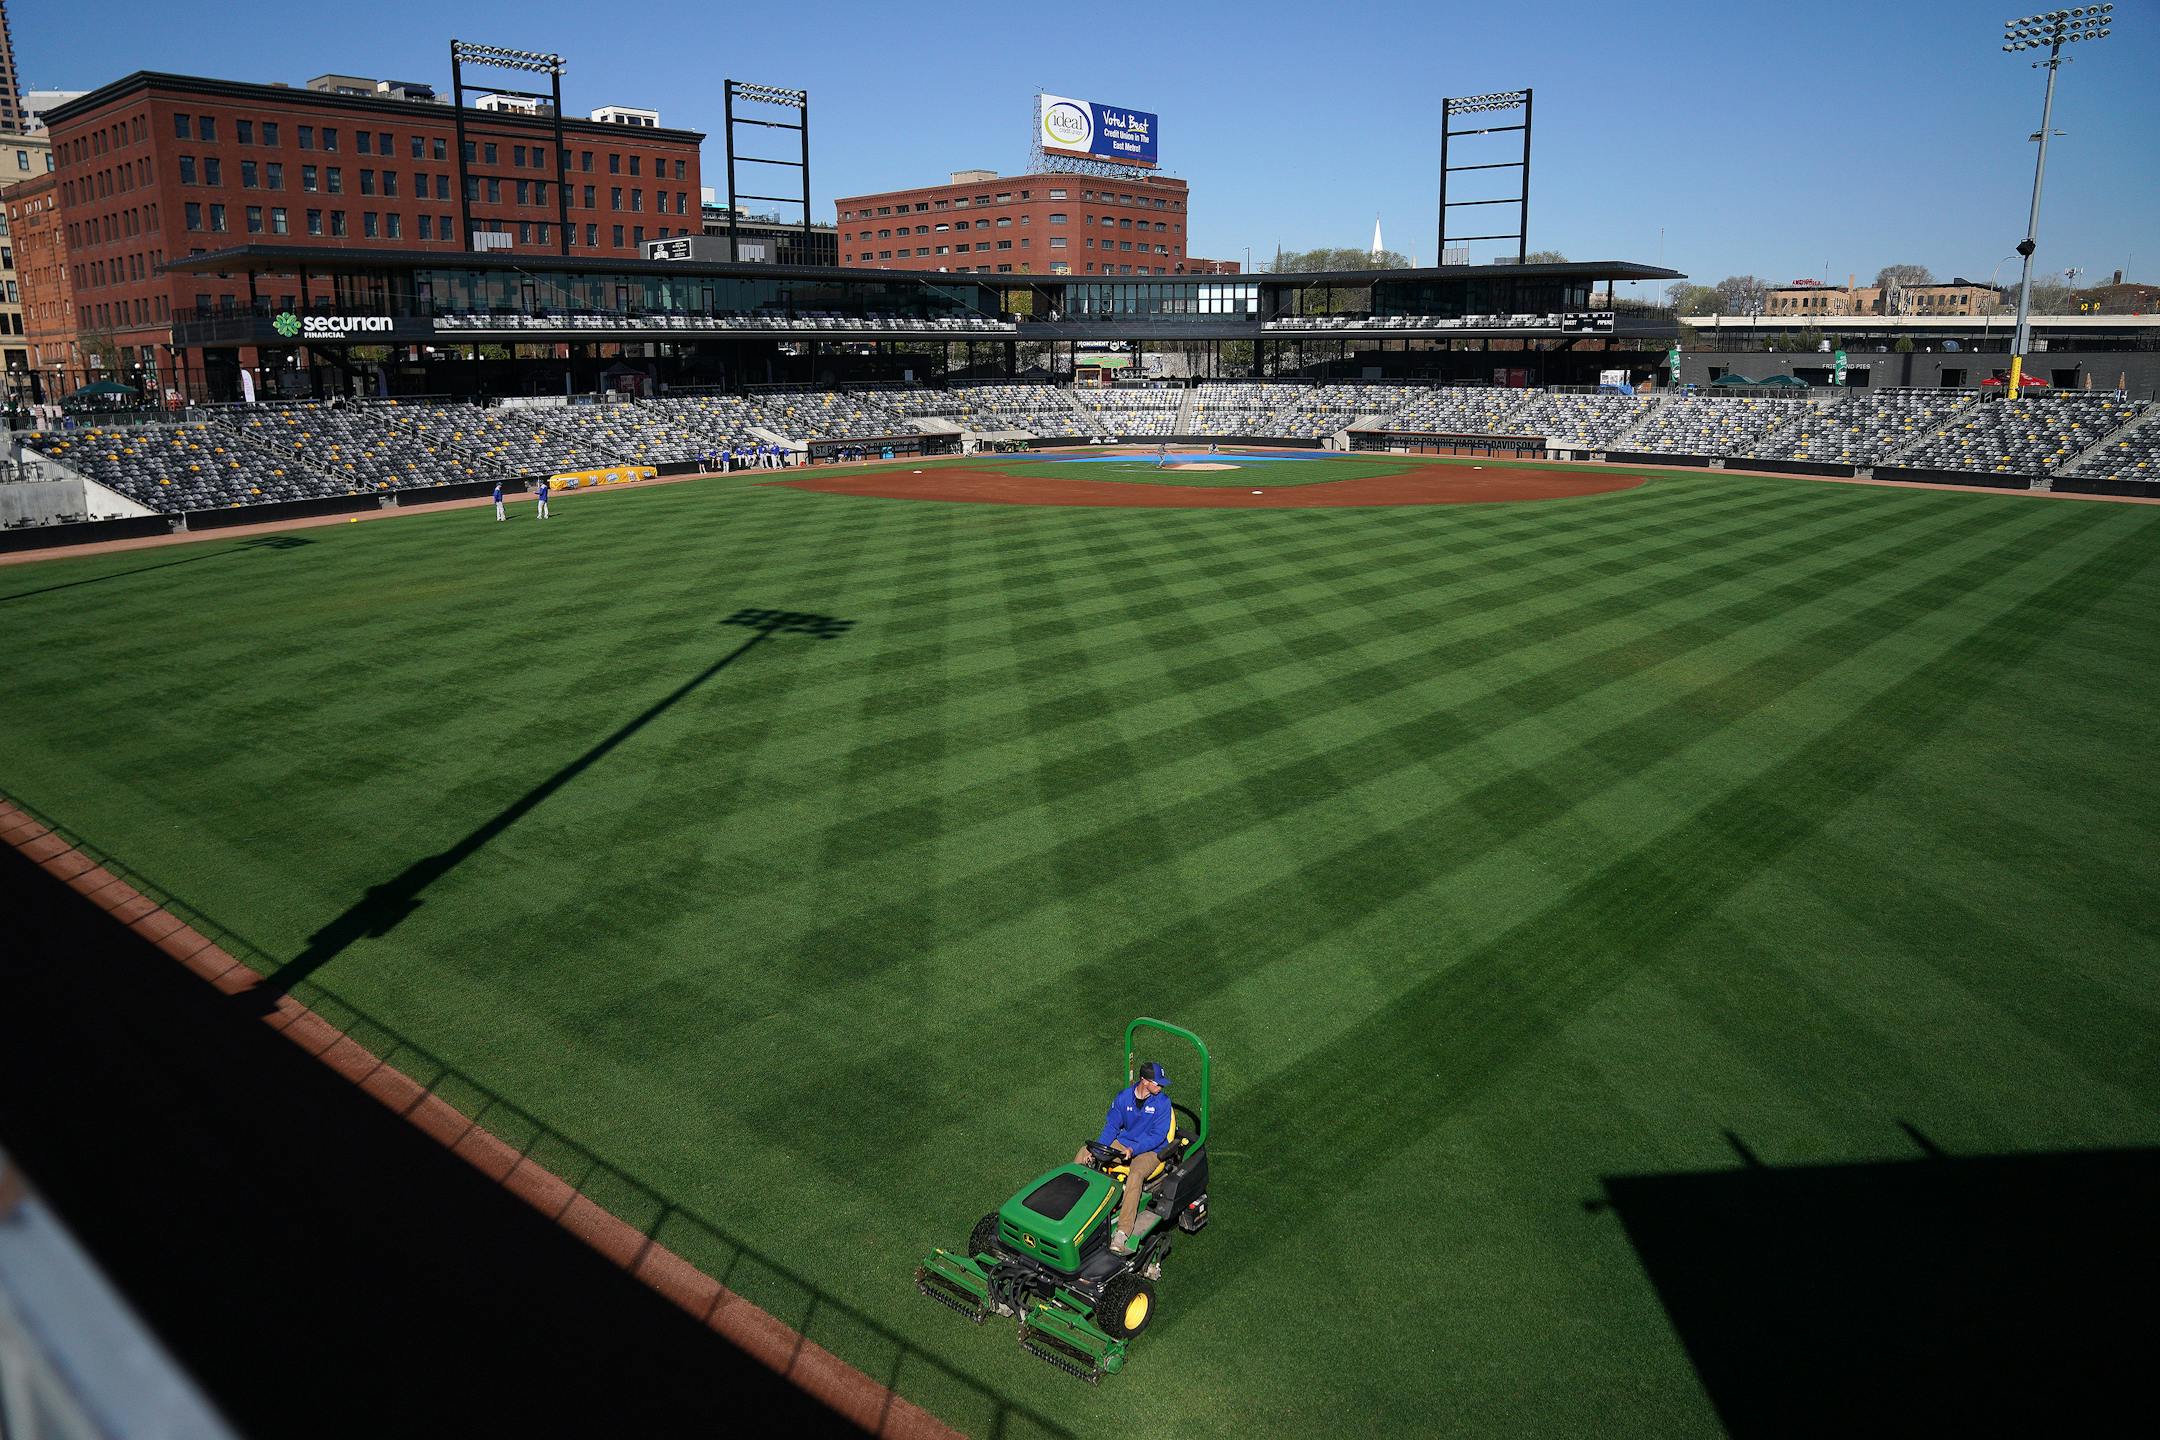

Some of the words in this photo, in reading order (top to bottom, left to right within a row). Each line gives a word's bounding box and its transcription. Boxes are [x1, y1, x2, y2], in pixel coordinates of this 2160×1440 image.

[1053, 112, 1083, 130] ideal
[1103, 110, 1126, 128] Voted
[1128, 114, 1149, 132] Best
[1104, 128, 1119, 138] Credit
[1120, 131, 1134, 141] Union
[1140, 134, 1150, 143] The
[1113, 141, 1124, 150] East
[1125, 142, 1141, 152] Metro!
[1421, 437, 1454, 447] PRAIRIE
[815, 445, 826, 455] ST.
